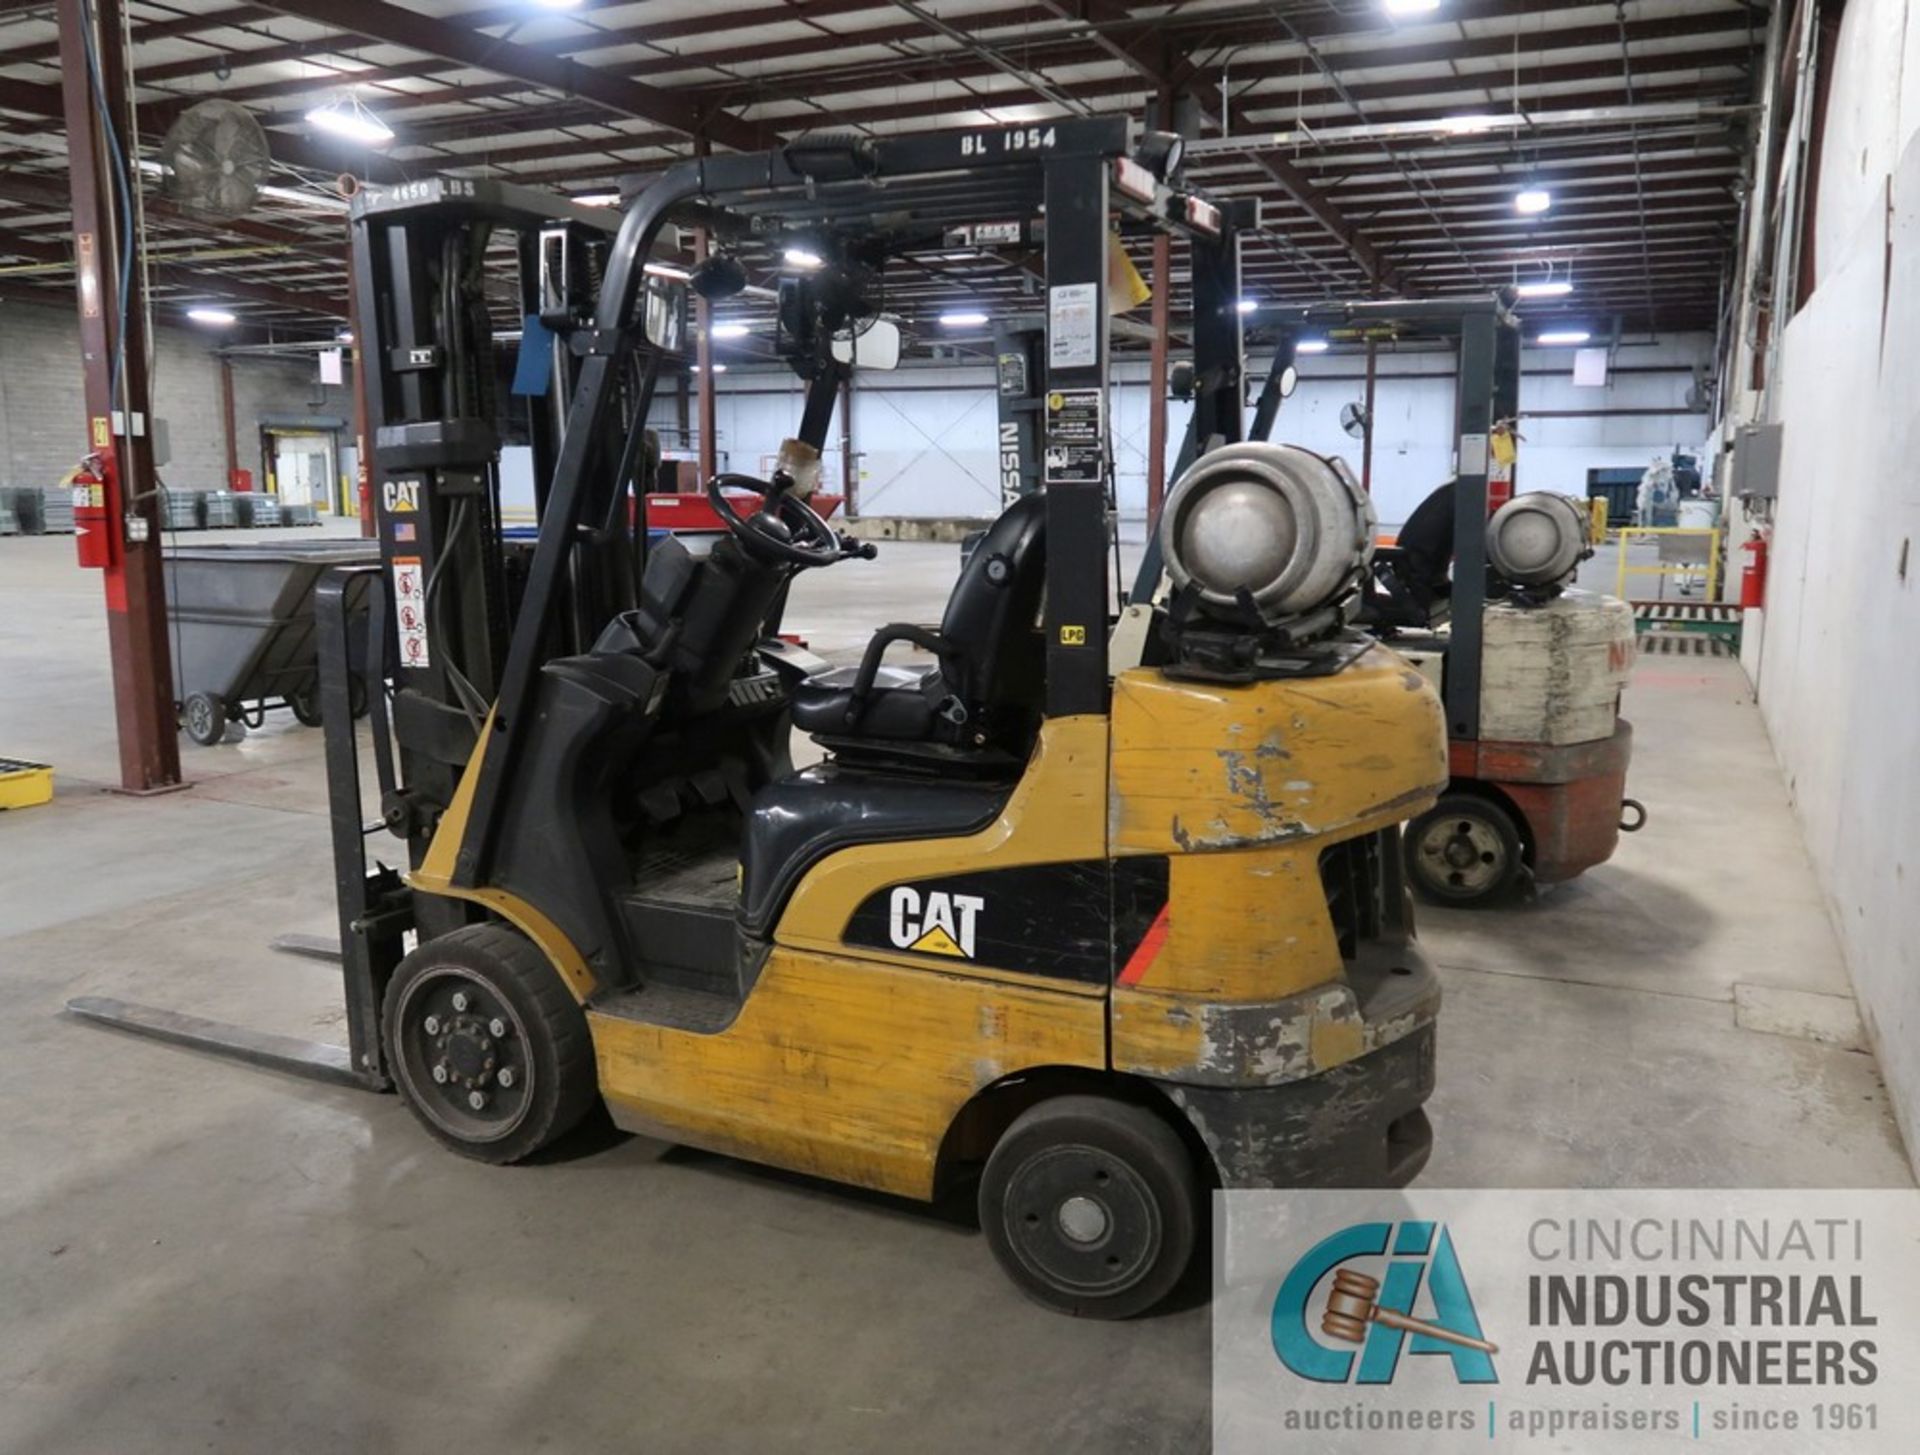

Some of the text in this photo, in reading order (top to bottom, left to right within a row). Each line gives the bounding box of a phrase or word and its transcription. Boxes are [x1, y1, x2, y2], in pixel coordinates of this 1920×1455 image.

[961, 127, 1056, 155] BL 1954
[440, 180, 475, 197] LBS
[1000, 421, 1022, 510] NISSA
[383, 480, 420, 512] CAT
[1063, 629, 1085, 641] LPG
[890, 886, 984, 959] CAT
